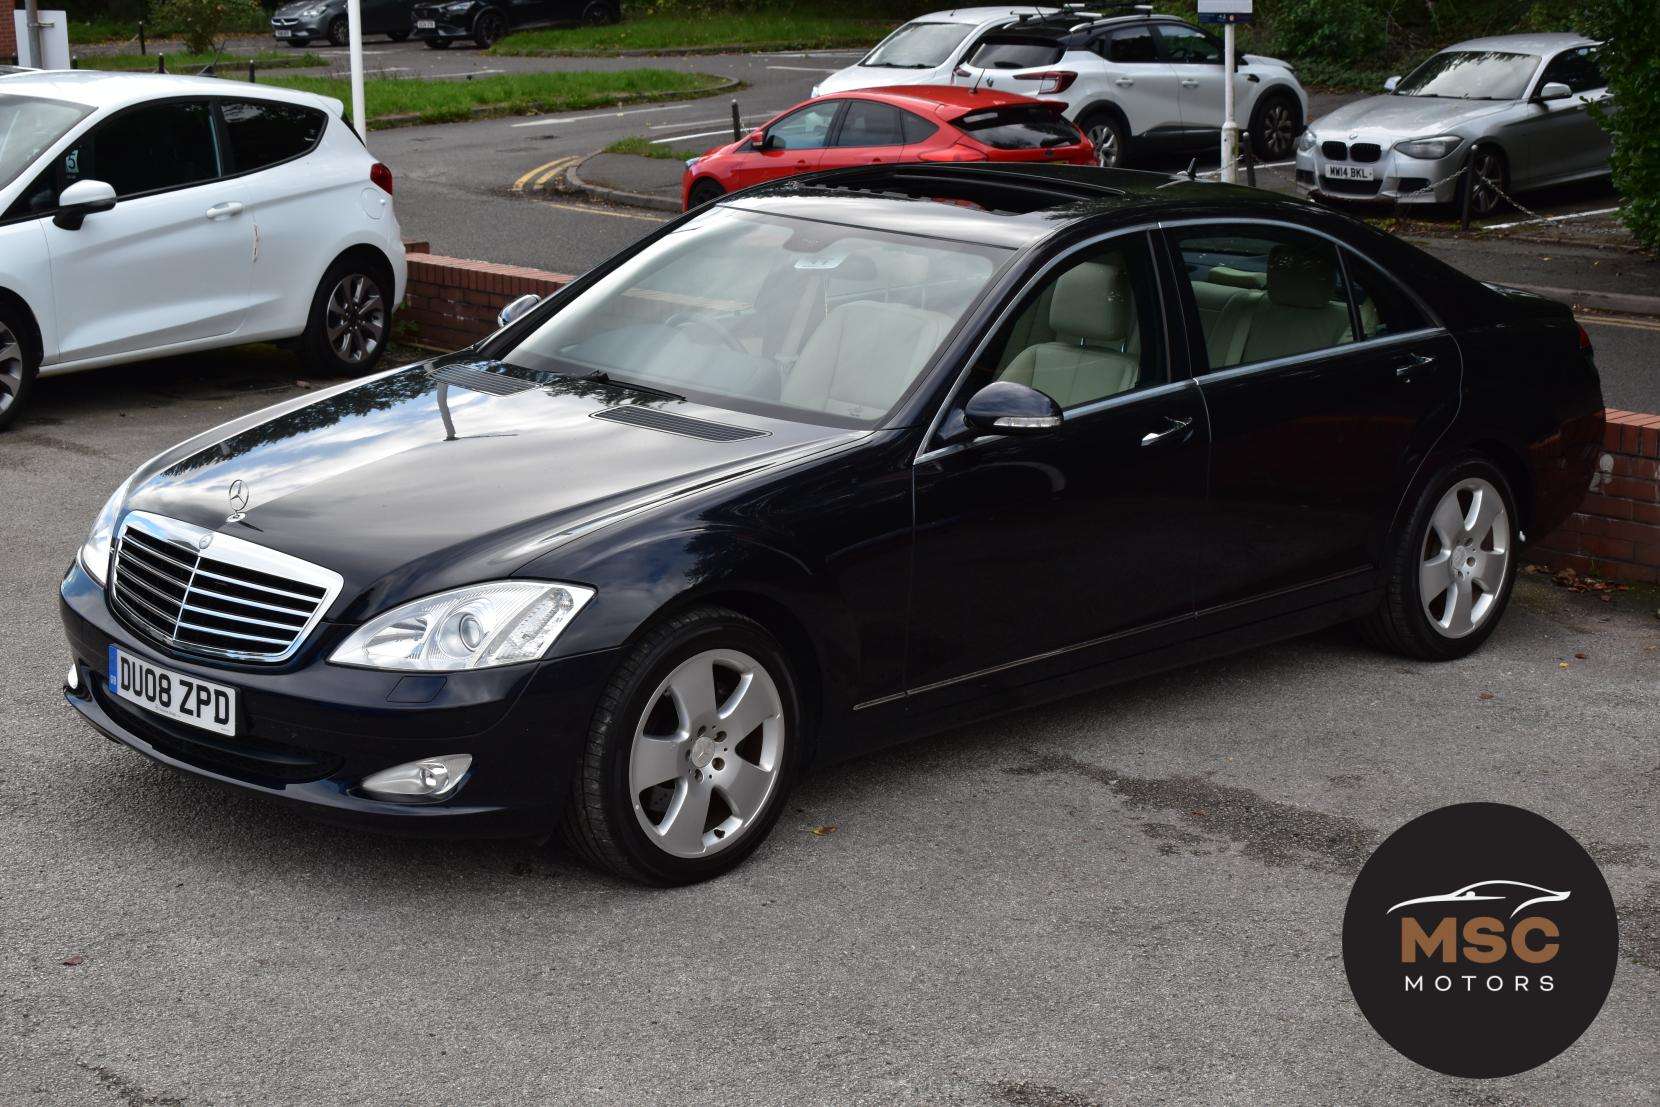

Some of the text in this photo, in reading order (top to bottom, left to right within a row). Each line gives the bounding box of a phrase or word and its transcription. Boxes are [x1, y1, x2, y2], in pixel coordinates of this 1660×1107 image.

[1350, 167, 1368, 179] BKL
[120, 656, 230, 725] DU08 ZPD
